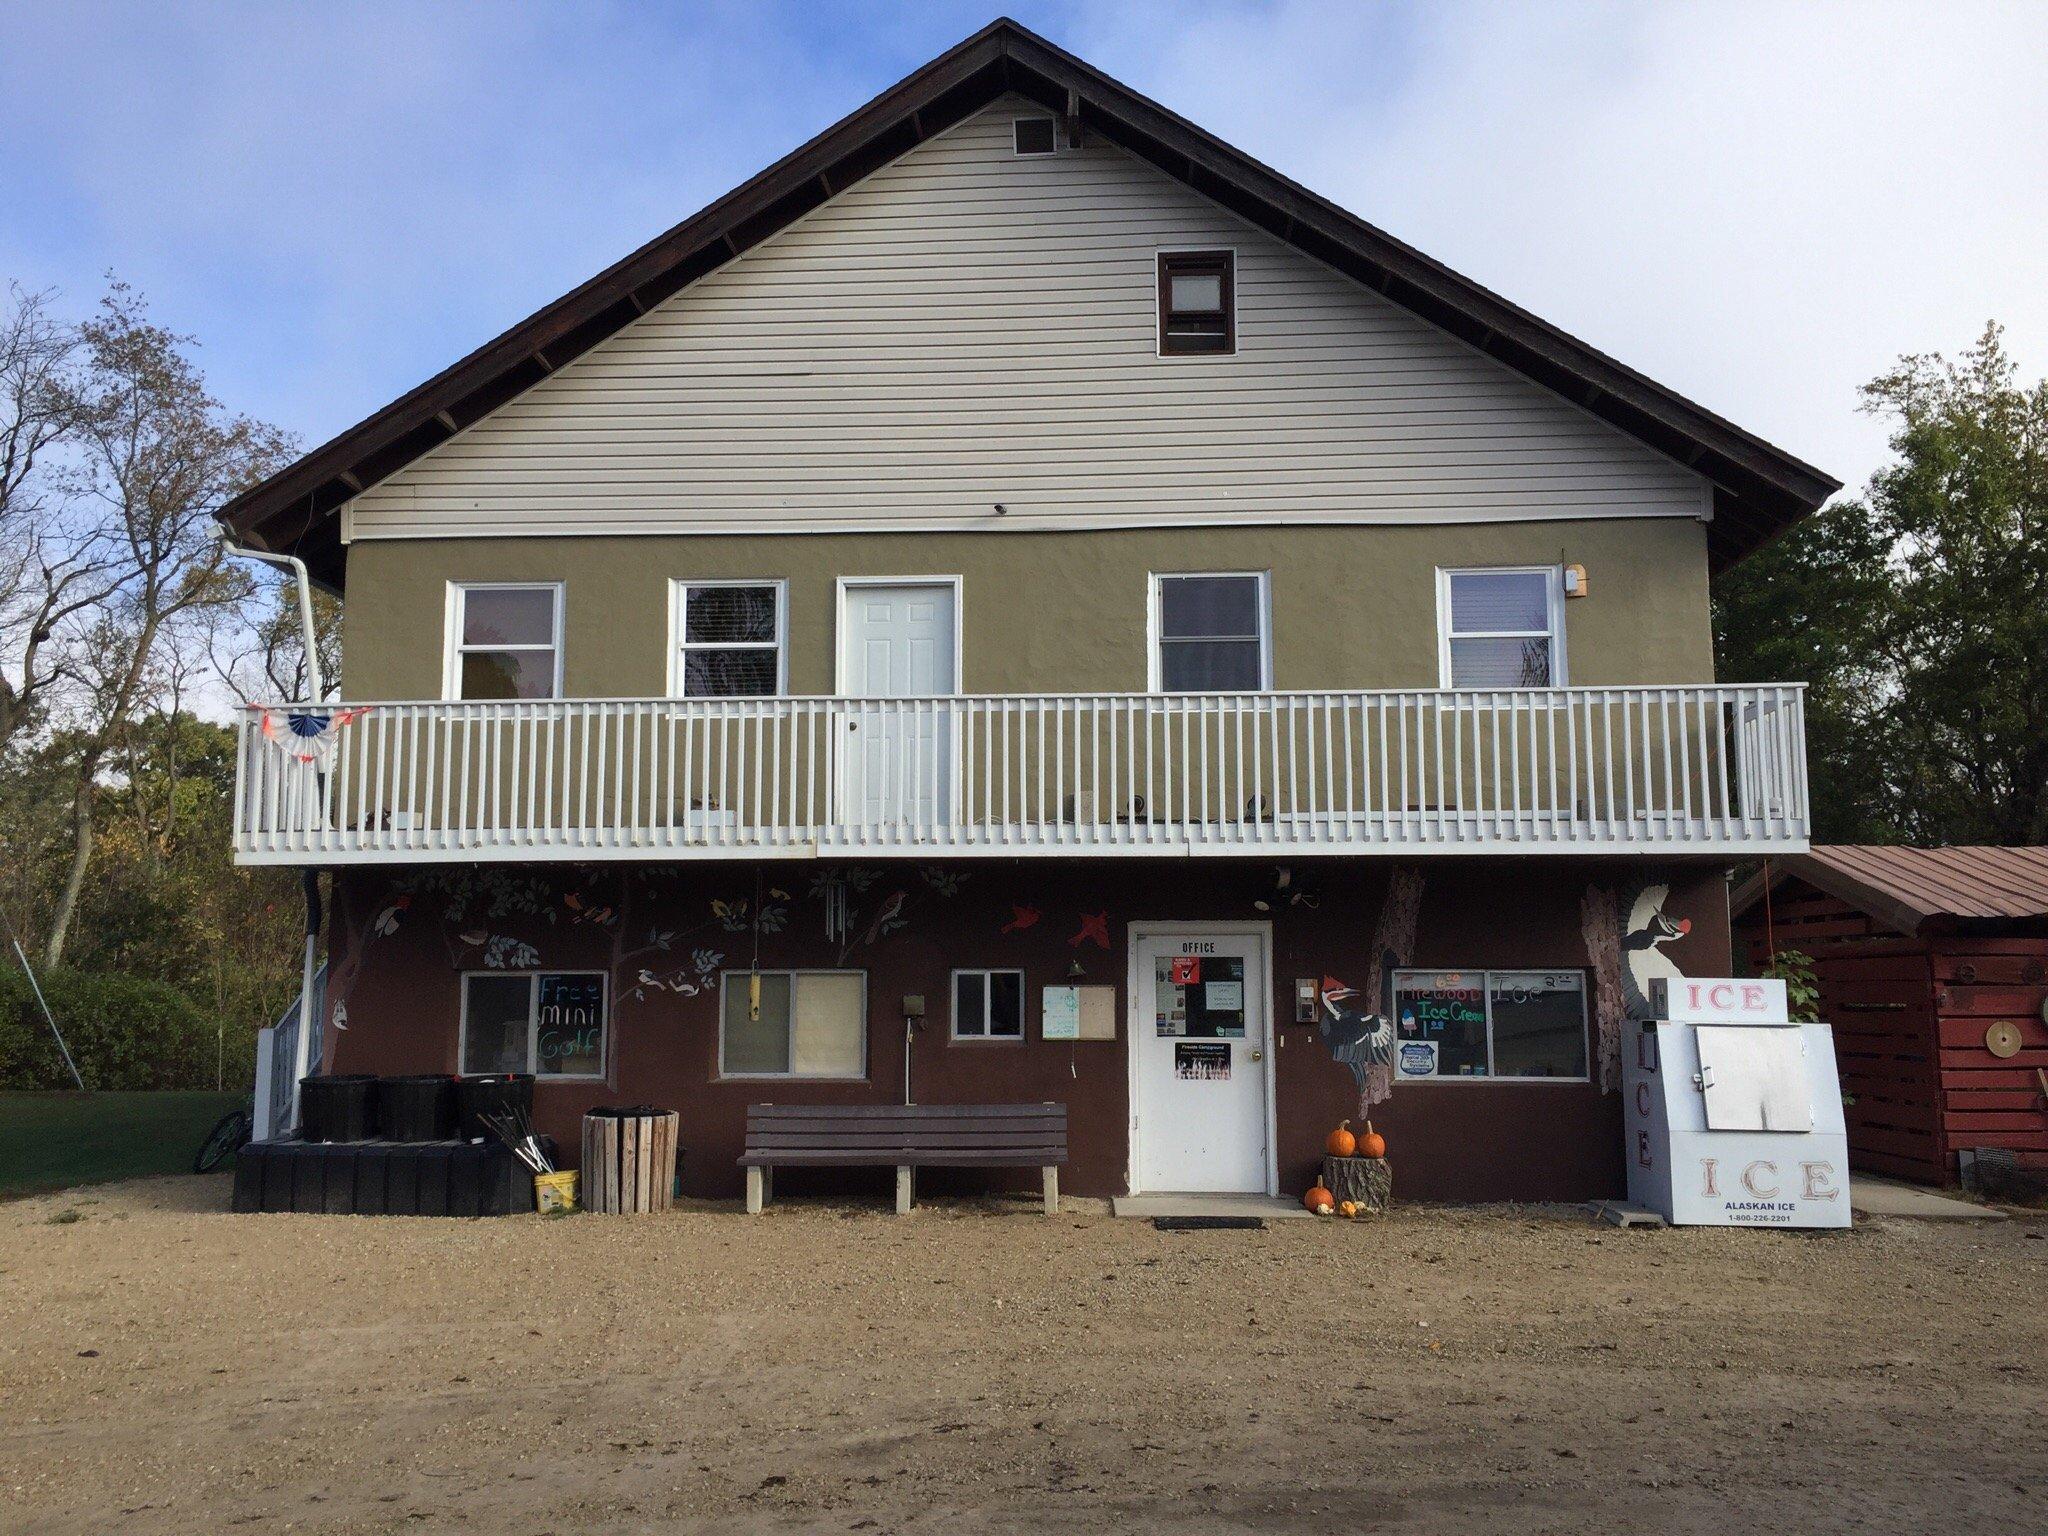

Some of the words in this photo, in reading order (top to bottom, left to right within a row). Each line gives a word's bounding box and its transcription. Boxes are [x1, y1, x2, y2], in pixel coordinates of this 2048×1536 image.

[1182, 942, 1215, 953] OFFICE
[541, 977, 600, 1003] Free
[1492, 976, 1542, 1004] Ice
[1686, 984, 1768, 1012] ICE
[1416, 1001, 1449, 1020] Ice
[539, 1028, 599, 1059] Golf
[1699, 1158, 1841, 1202] ICE
[1725, 1201, 1775, 1211] ALASKAN
[1778, 1202, 1796, 1211] ICE
[1728, 1214, 1791, 1222] 1-800-226-2201
